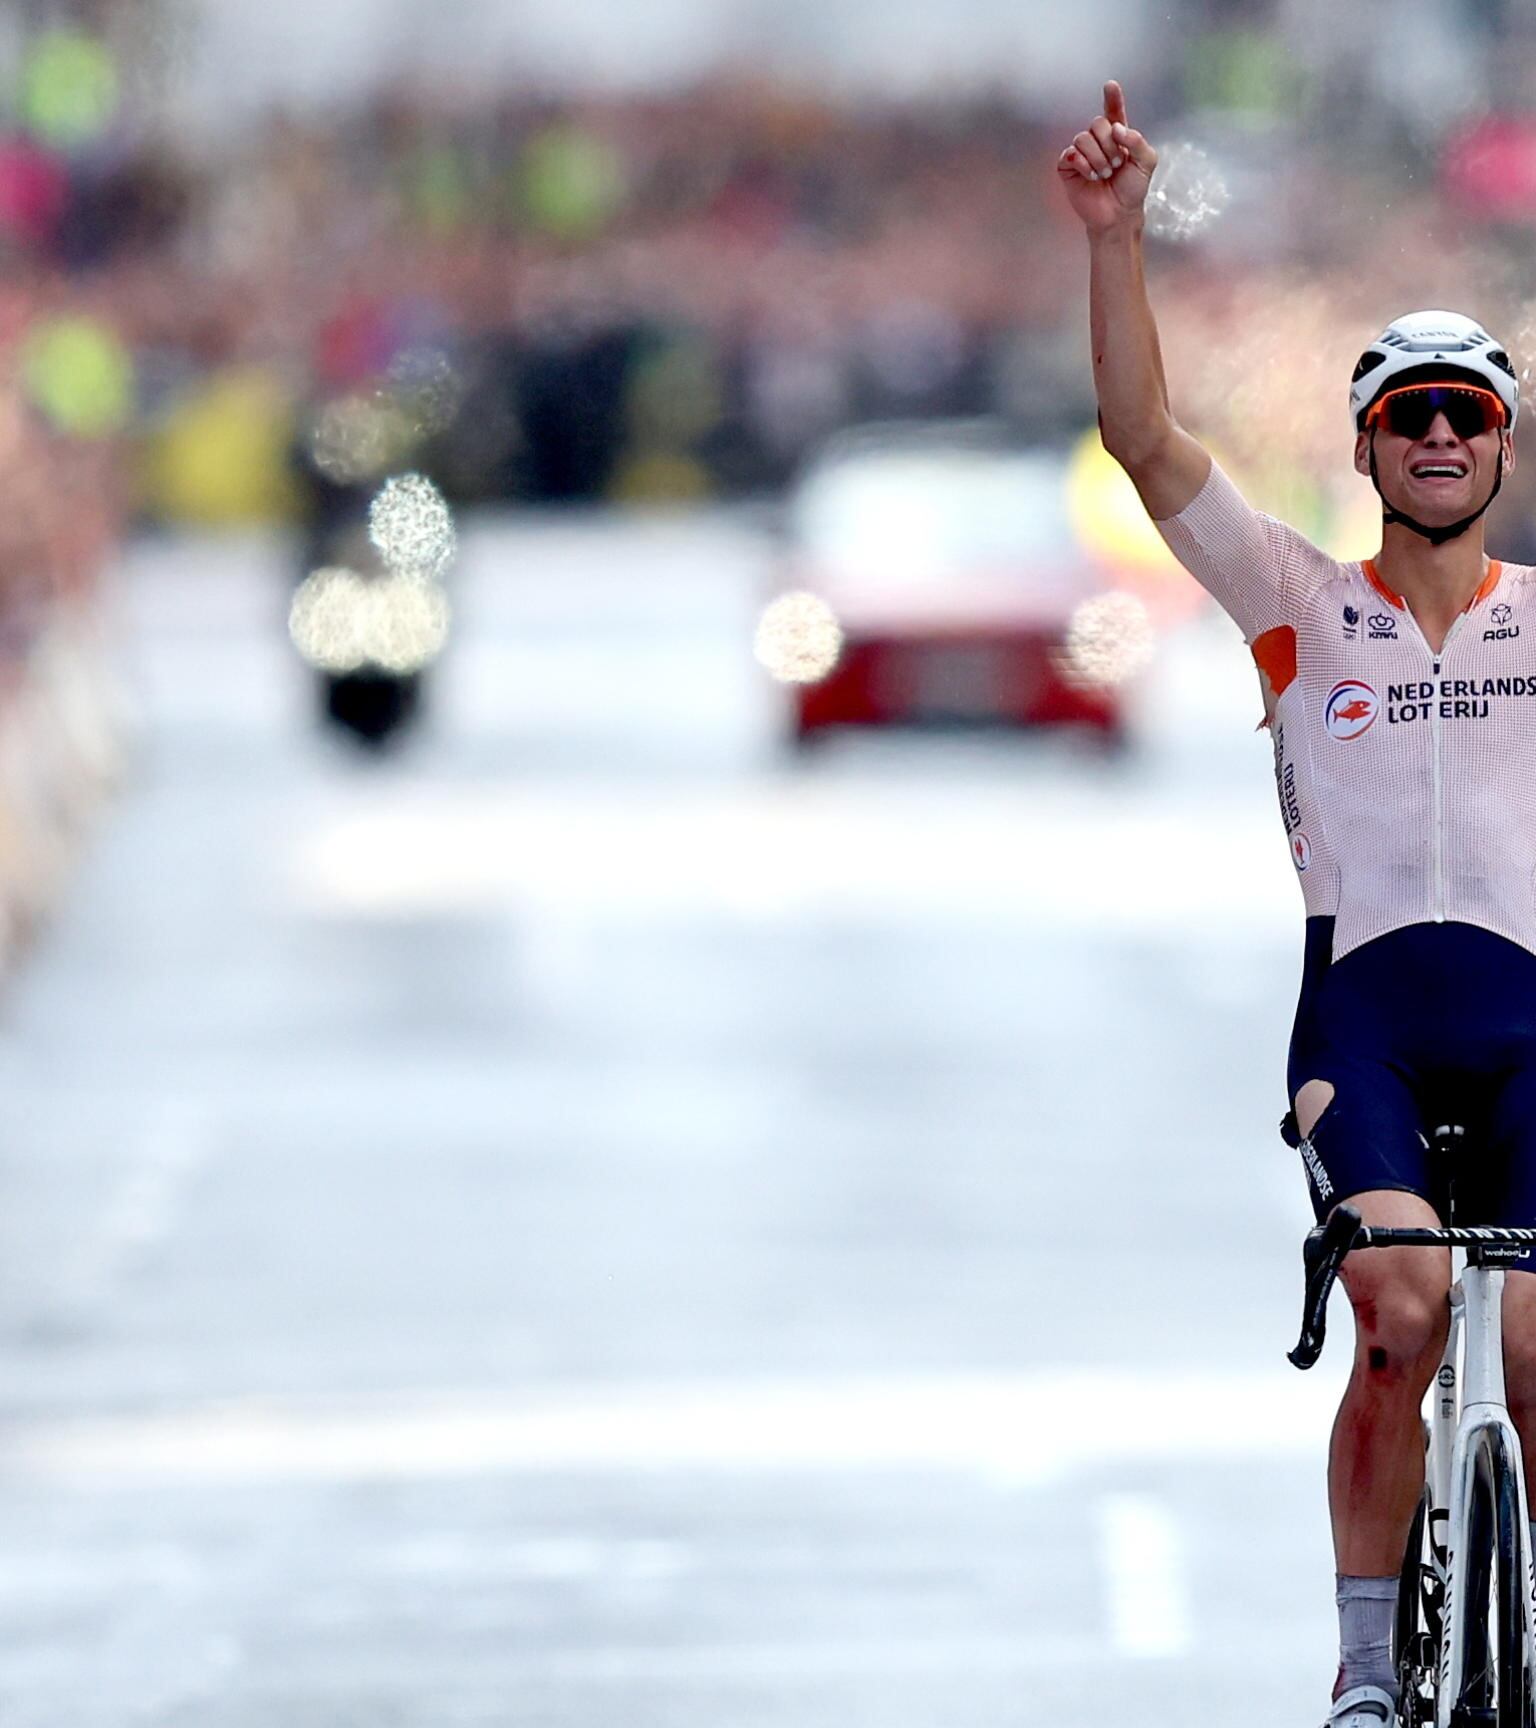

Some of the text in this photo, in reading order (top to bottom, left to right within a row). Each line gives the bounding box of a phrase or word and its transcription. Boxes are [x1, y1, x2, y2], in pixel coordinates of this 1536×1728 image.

[1483, 625, 1520, 642] AGU
[1388, 700, 1489, 724] LOTERIJ
[1283, 762, 1301, 829] LOTERIJ
